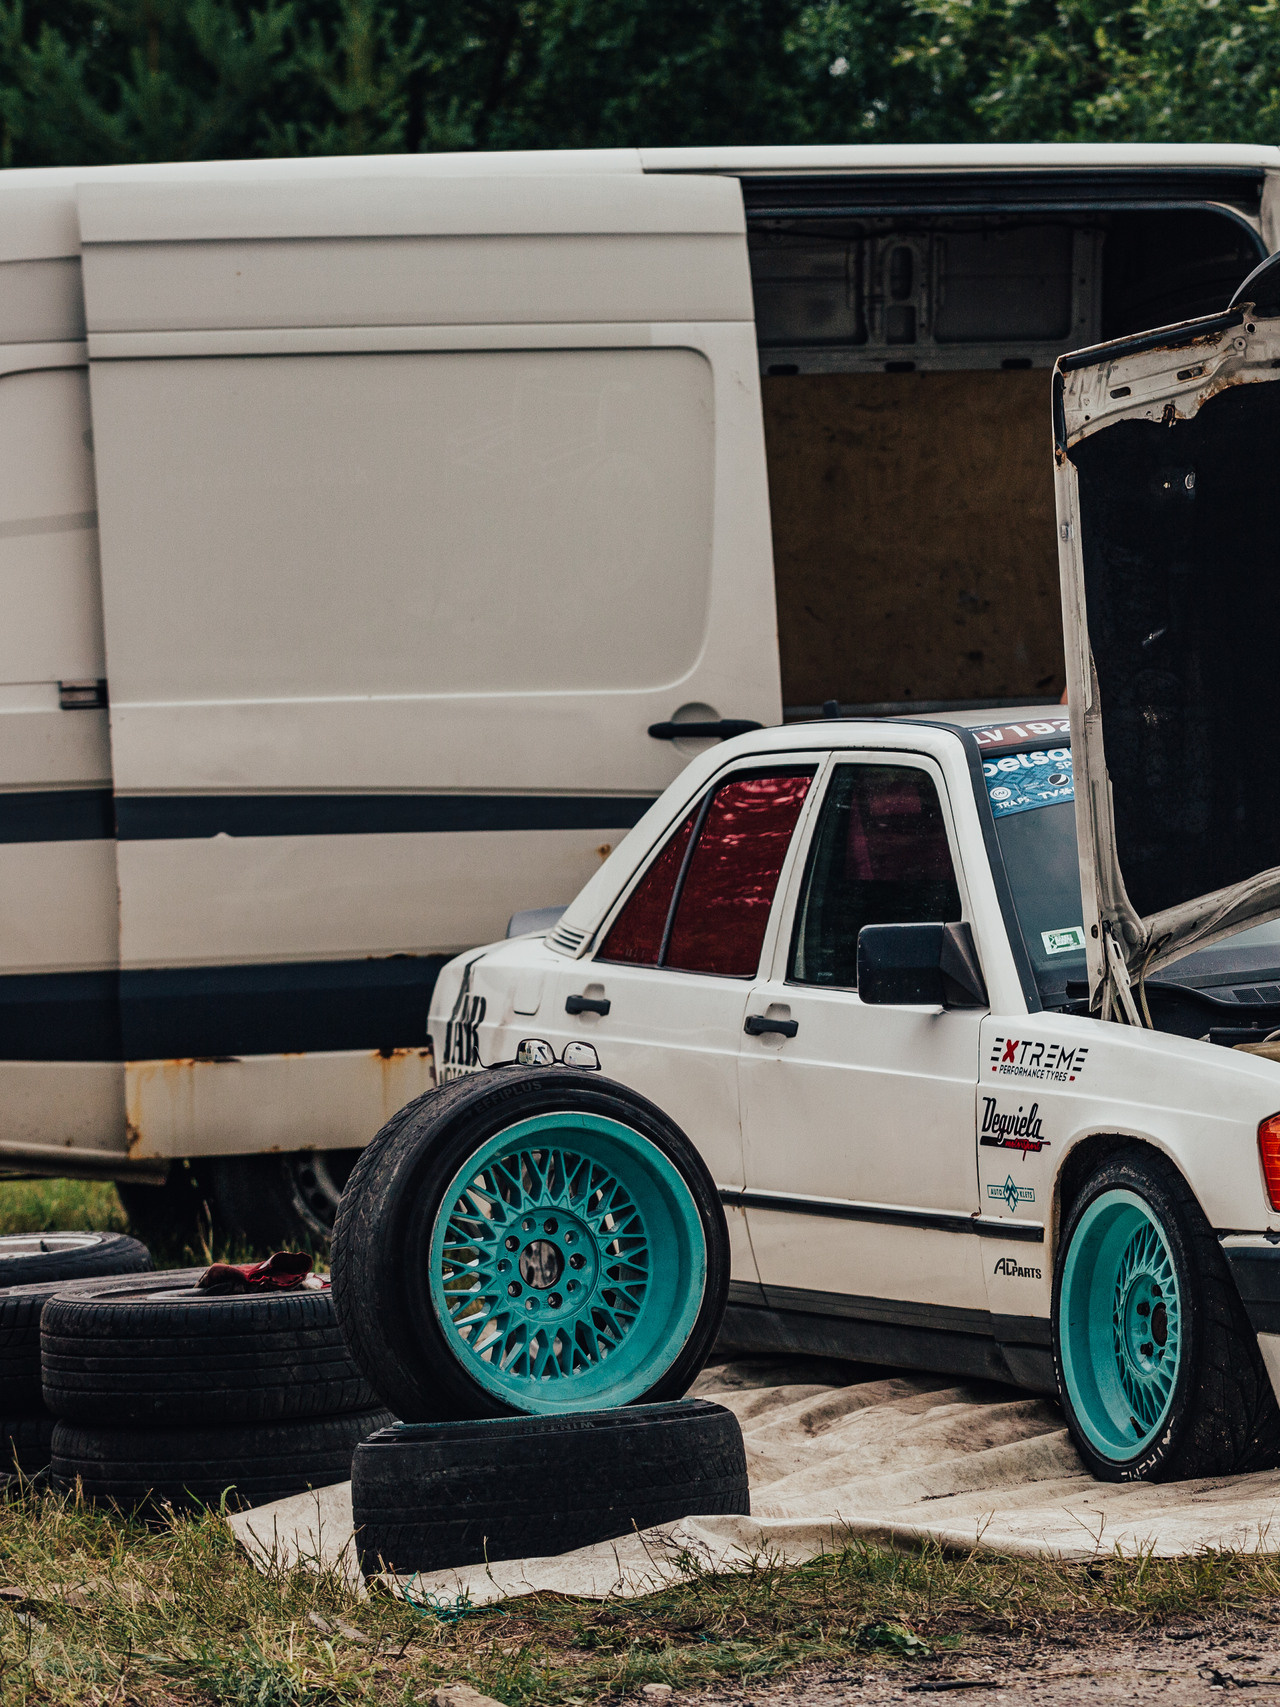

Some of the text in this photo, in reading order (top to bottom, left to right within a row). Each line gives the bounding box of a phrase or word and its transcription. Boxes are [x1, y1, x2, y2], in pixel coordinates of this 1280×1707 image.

[972, 729, 1004, 745] LV
[983, 747, 1072, 777] etsa
[990, 1037, 1089, 1072] EXTREME
[999, 1064, 1068, 1082] PERFORMANCE TYRES
[474, 1080, 542, 1114] EFFIPLUS
